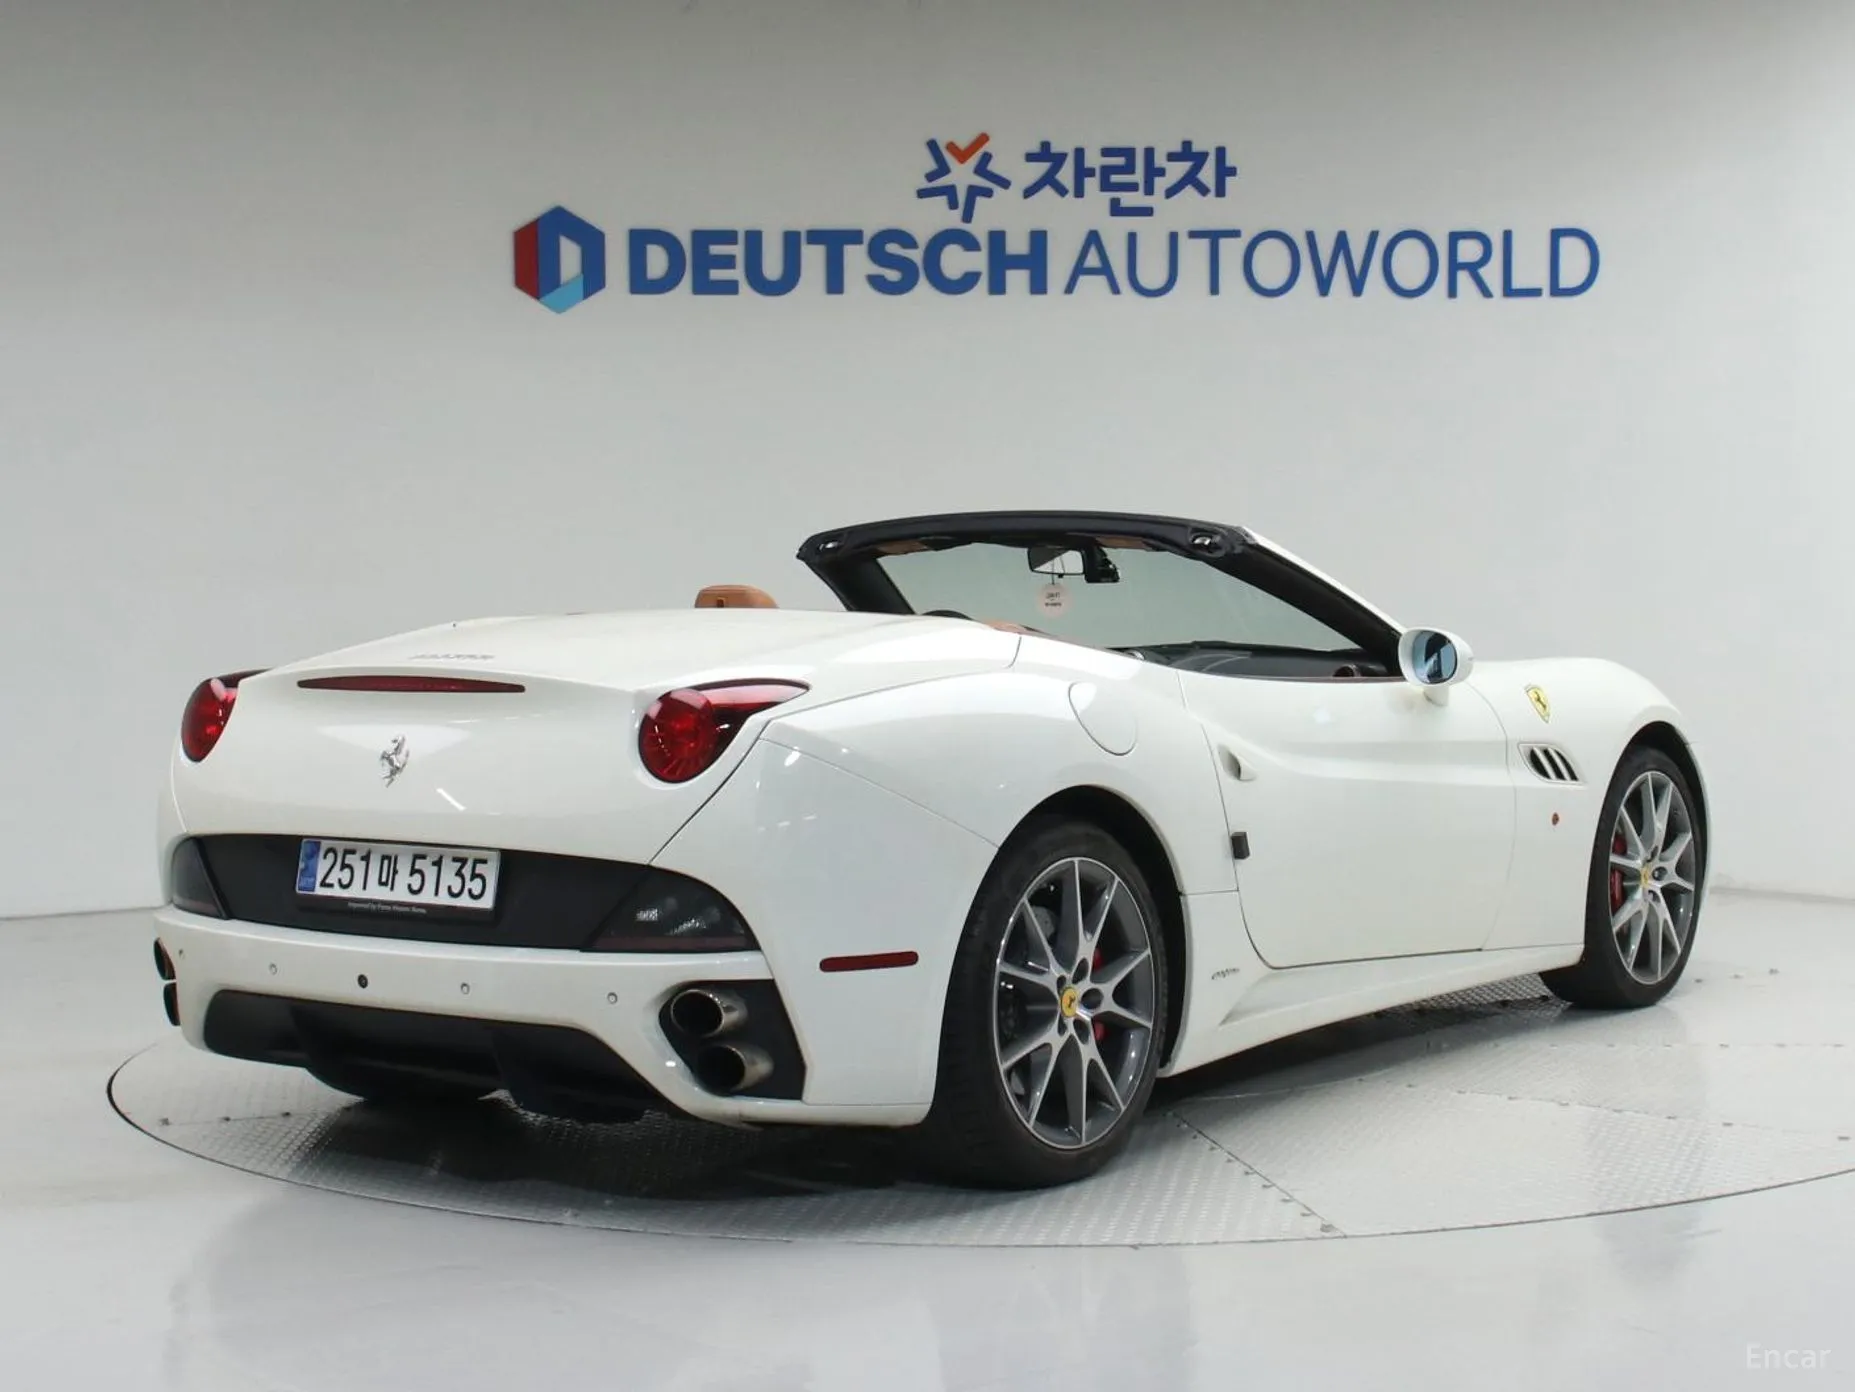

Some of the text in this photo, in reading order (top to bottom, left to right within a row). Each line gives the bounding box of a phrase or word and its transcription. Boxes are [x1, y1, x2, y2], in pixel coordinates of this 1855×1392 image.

[1023, 140, 1237, 217] 차란차
[628, 227, 1600, 299] DEUTSCH AUTOWORLD
